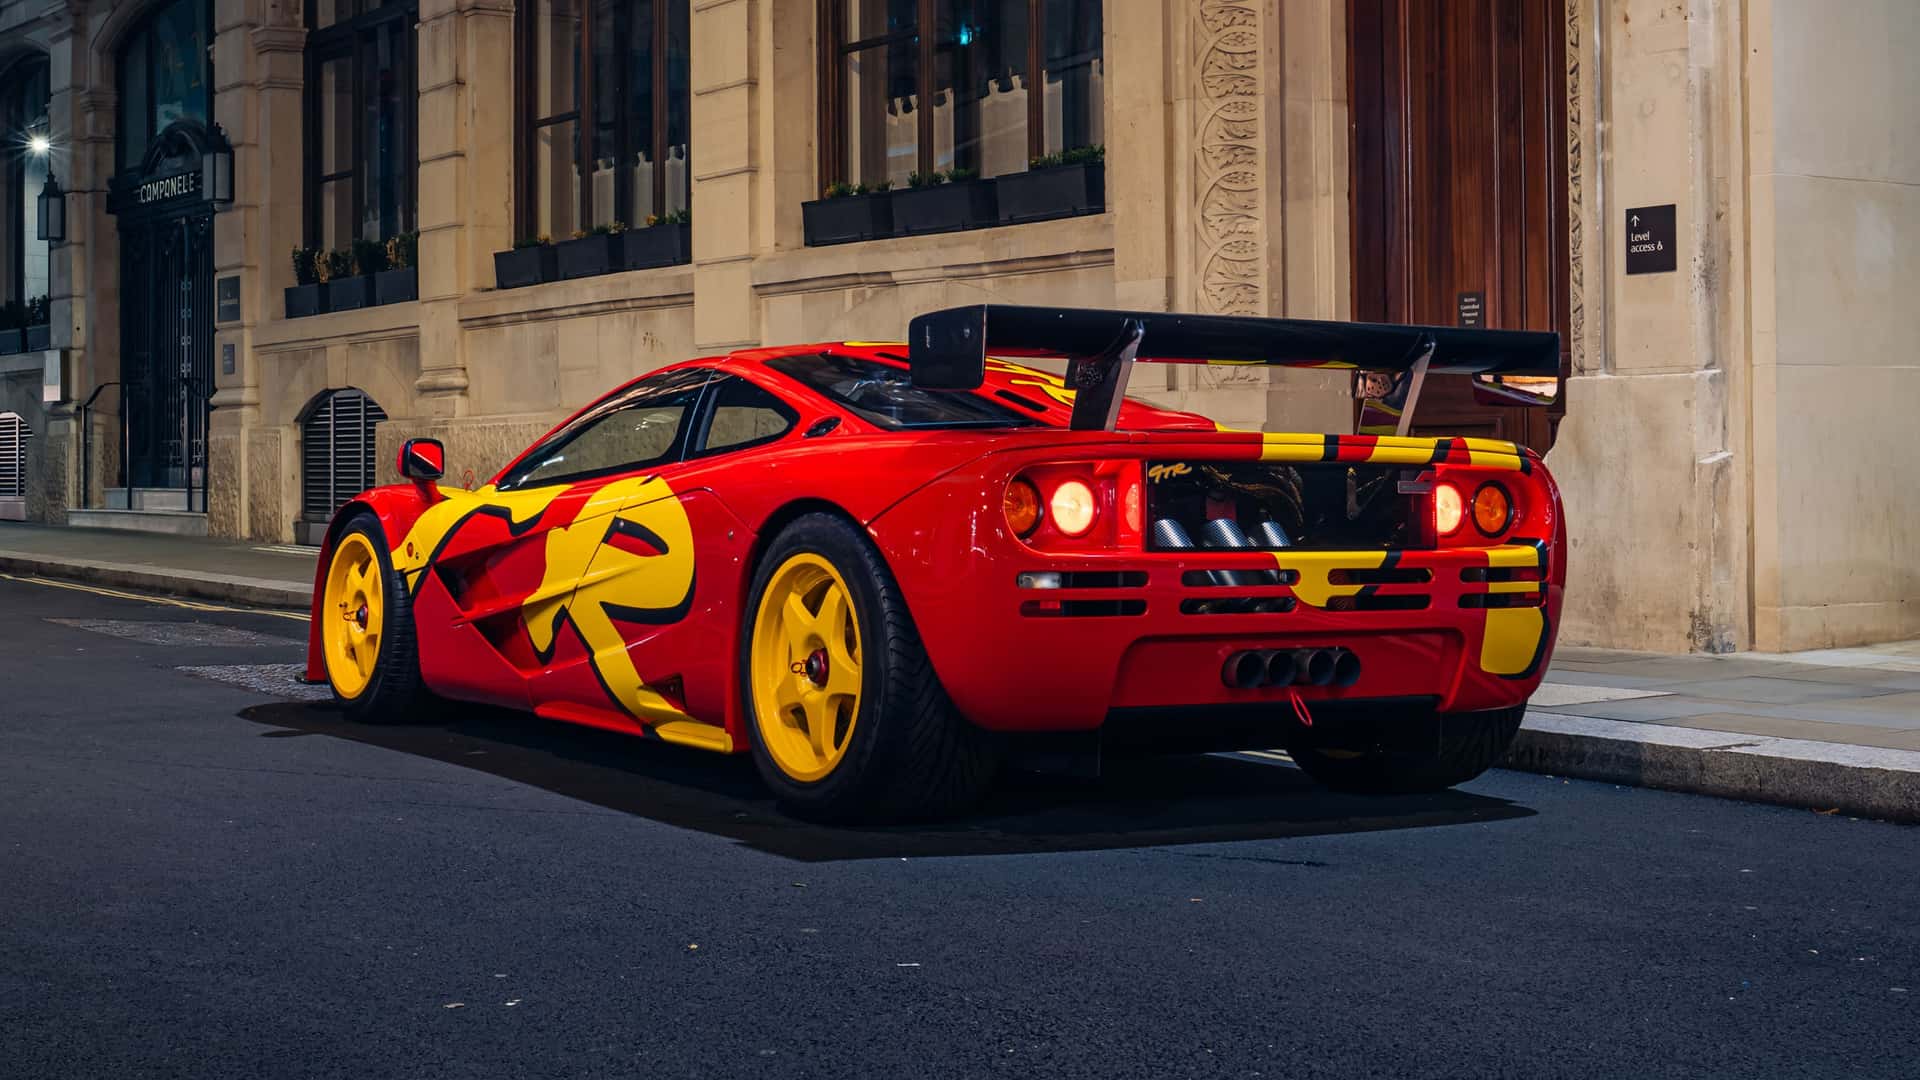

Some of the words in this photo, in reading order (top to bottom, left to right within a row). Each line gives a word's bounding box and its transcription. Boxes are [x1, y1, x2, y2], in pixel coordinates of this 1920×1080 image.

[1631, 231, 1650, 242] Level
[1630, 243, 1656, 254] access
[1148, 462, 1193, 484] GTR
